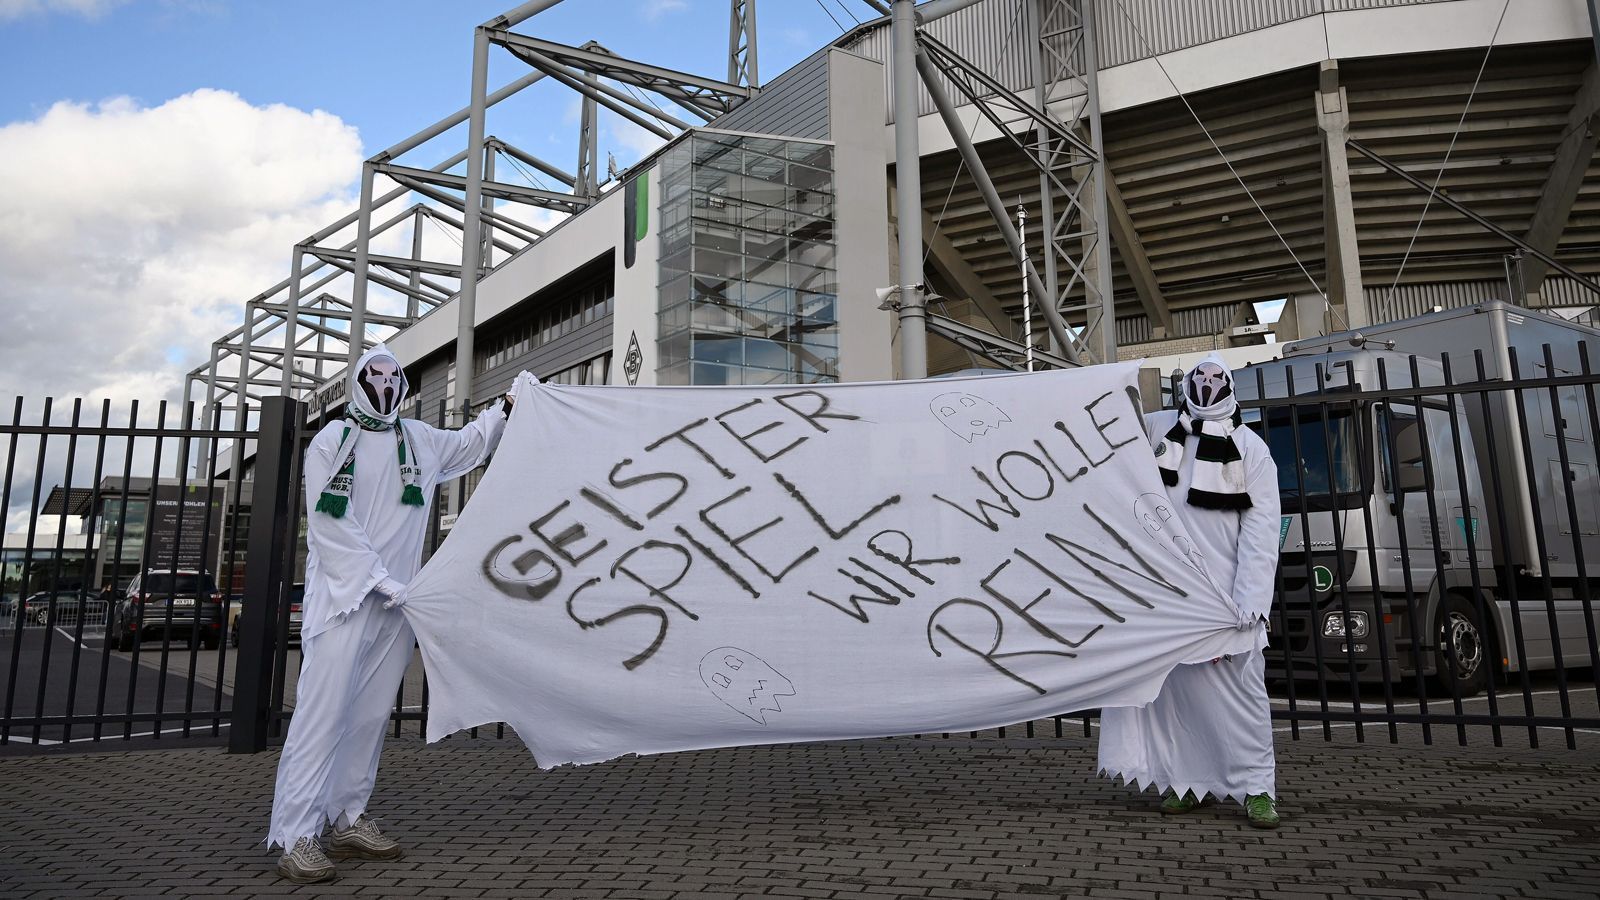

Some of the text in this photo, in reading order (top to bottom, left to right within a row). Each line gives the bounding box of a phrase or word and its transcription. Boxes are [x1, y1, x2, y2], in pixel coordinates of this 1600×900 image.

[482, 390, 860, 601] GEISTER
[567, 472, 900, 670] SPIEL
[807, 529, 961, 623] WIR
[1314, 571, 1326, 587] L
[927, 503, 1188, 694] REIN
